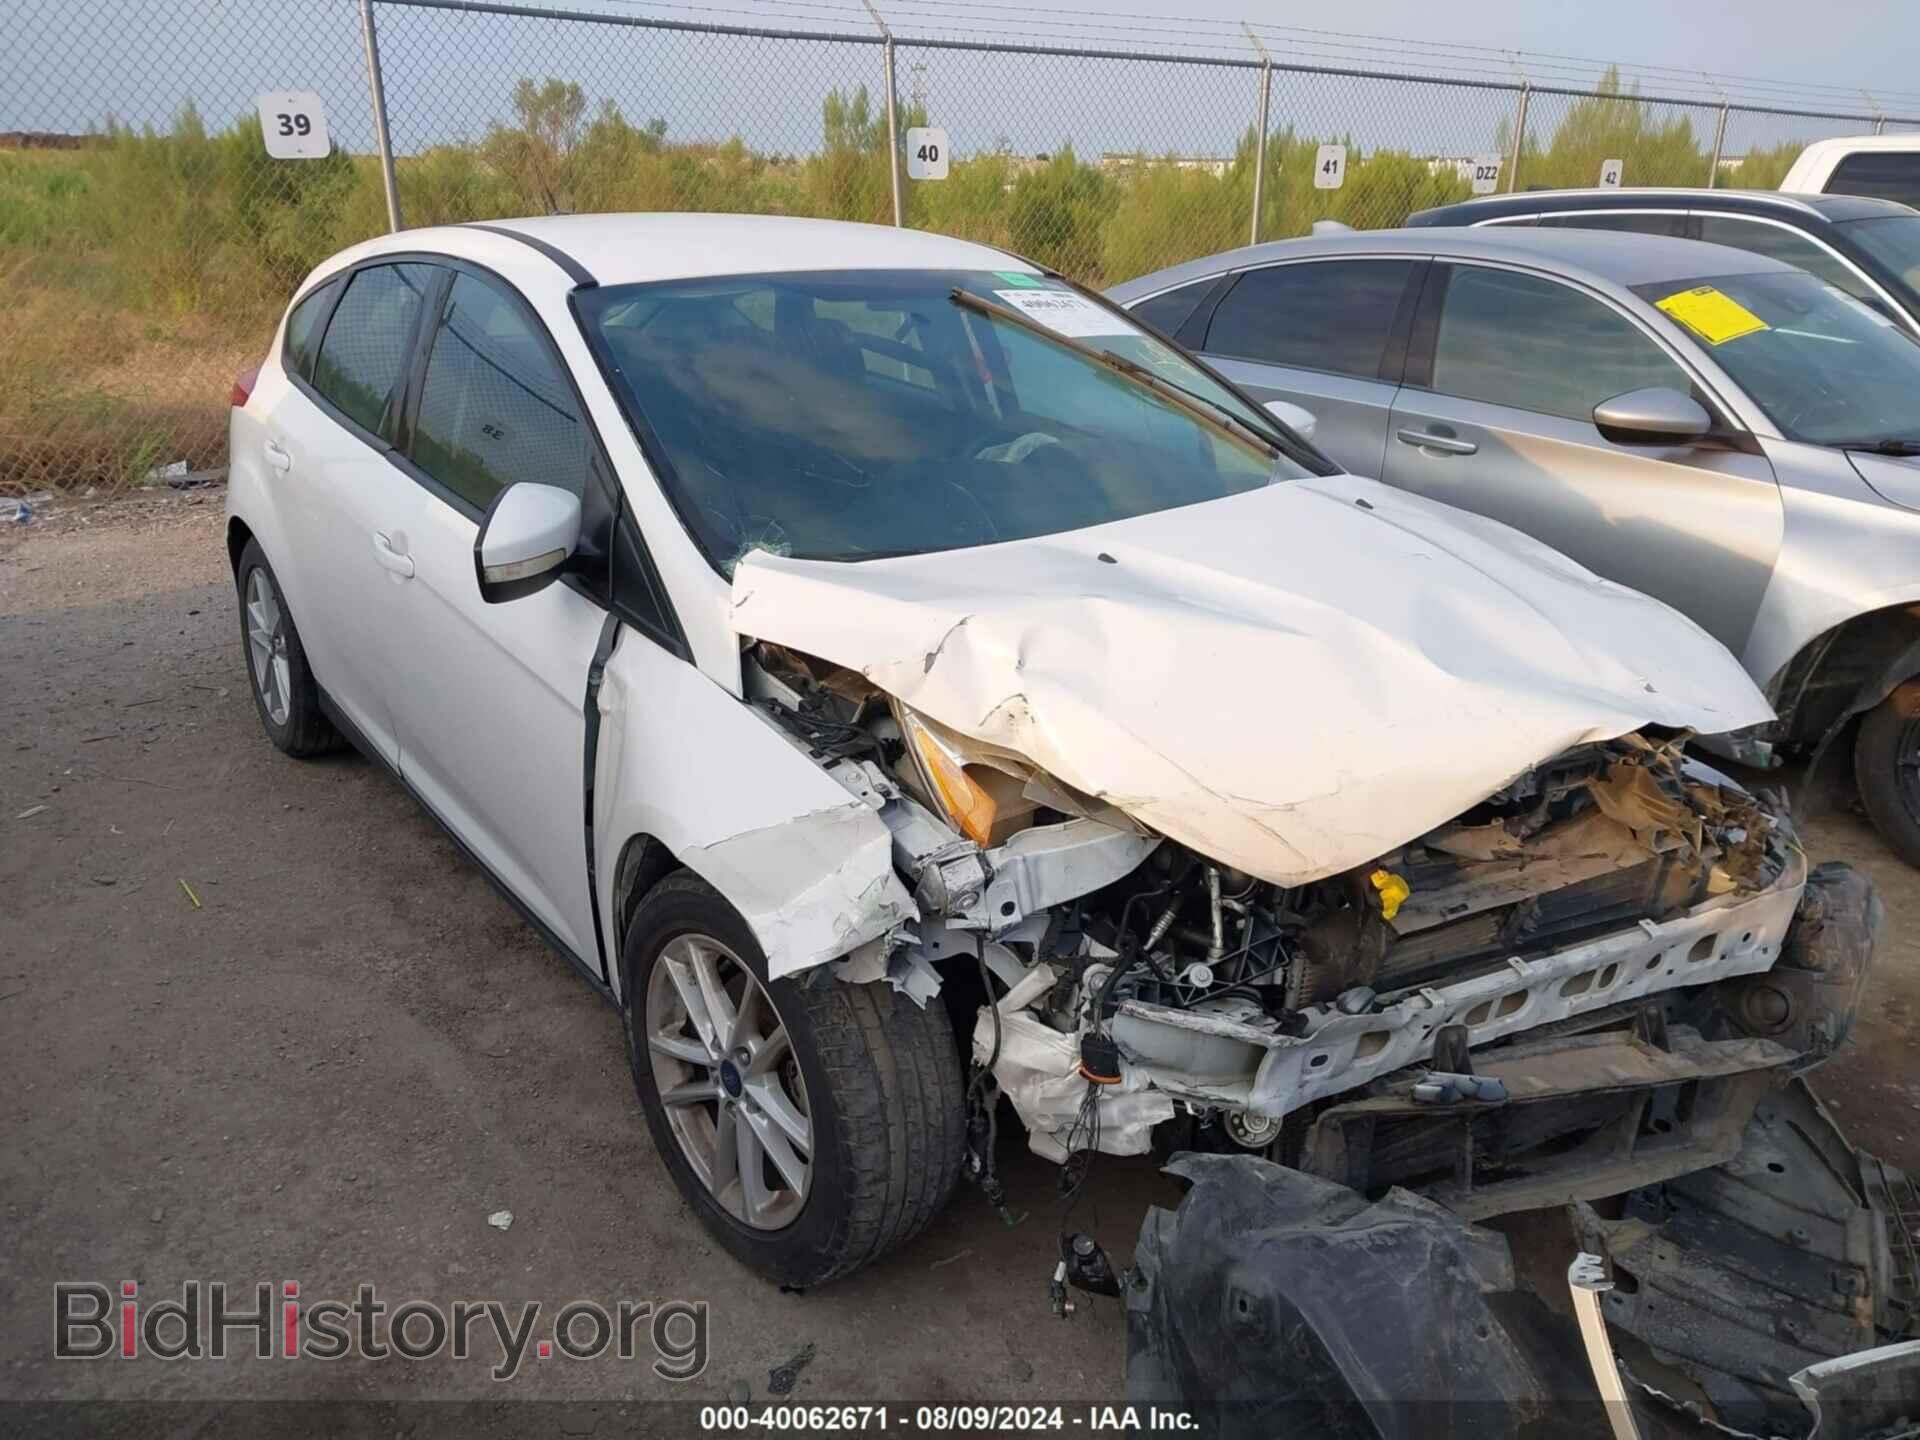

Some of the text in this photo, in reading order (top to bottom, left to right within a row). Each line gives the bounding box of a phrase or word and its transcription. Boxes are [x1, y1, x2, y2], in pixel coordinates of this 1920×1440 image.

[277, 113, 311, 136] 39
[917, 144, 939, 162] 40
[1322, 159, 1338, 174] 41
[1476, 166, 1498, 180] DZ2
[1605, 171, 1617, 185] 42
